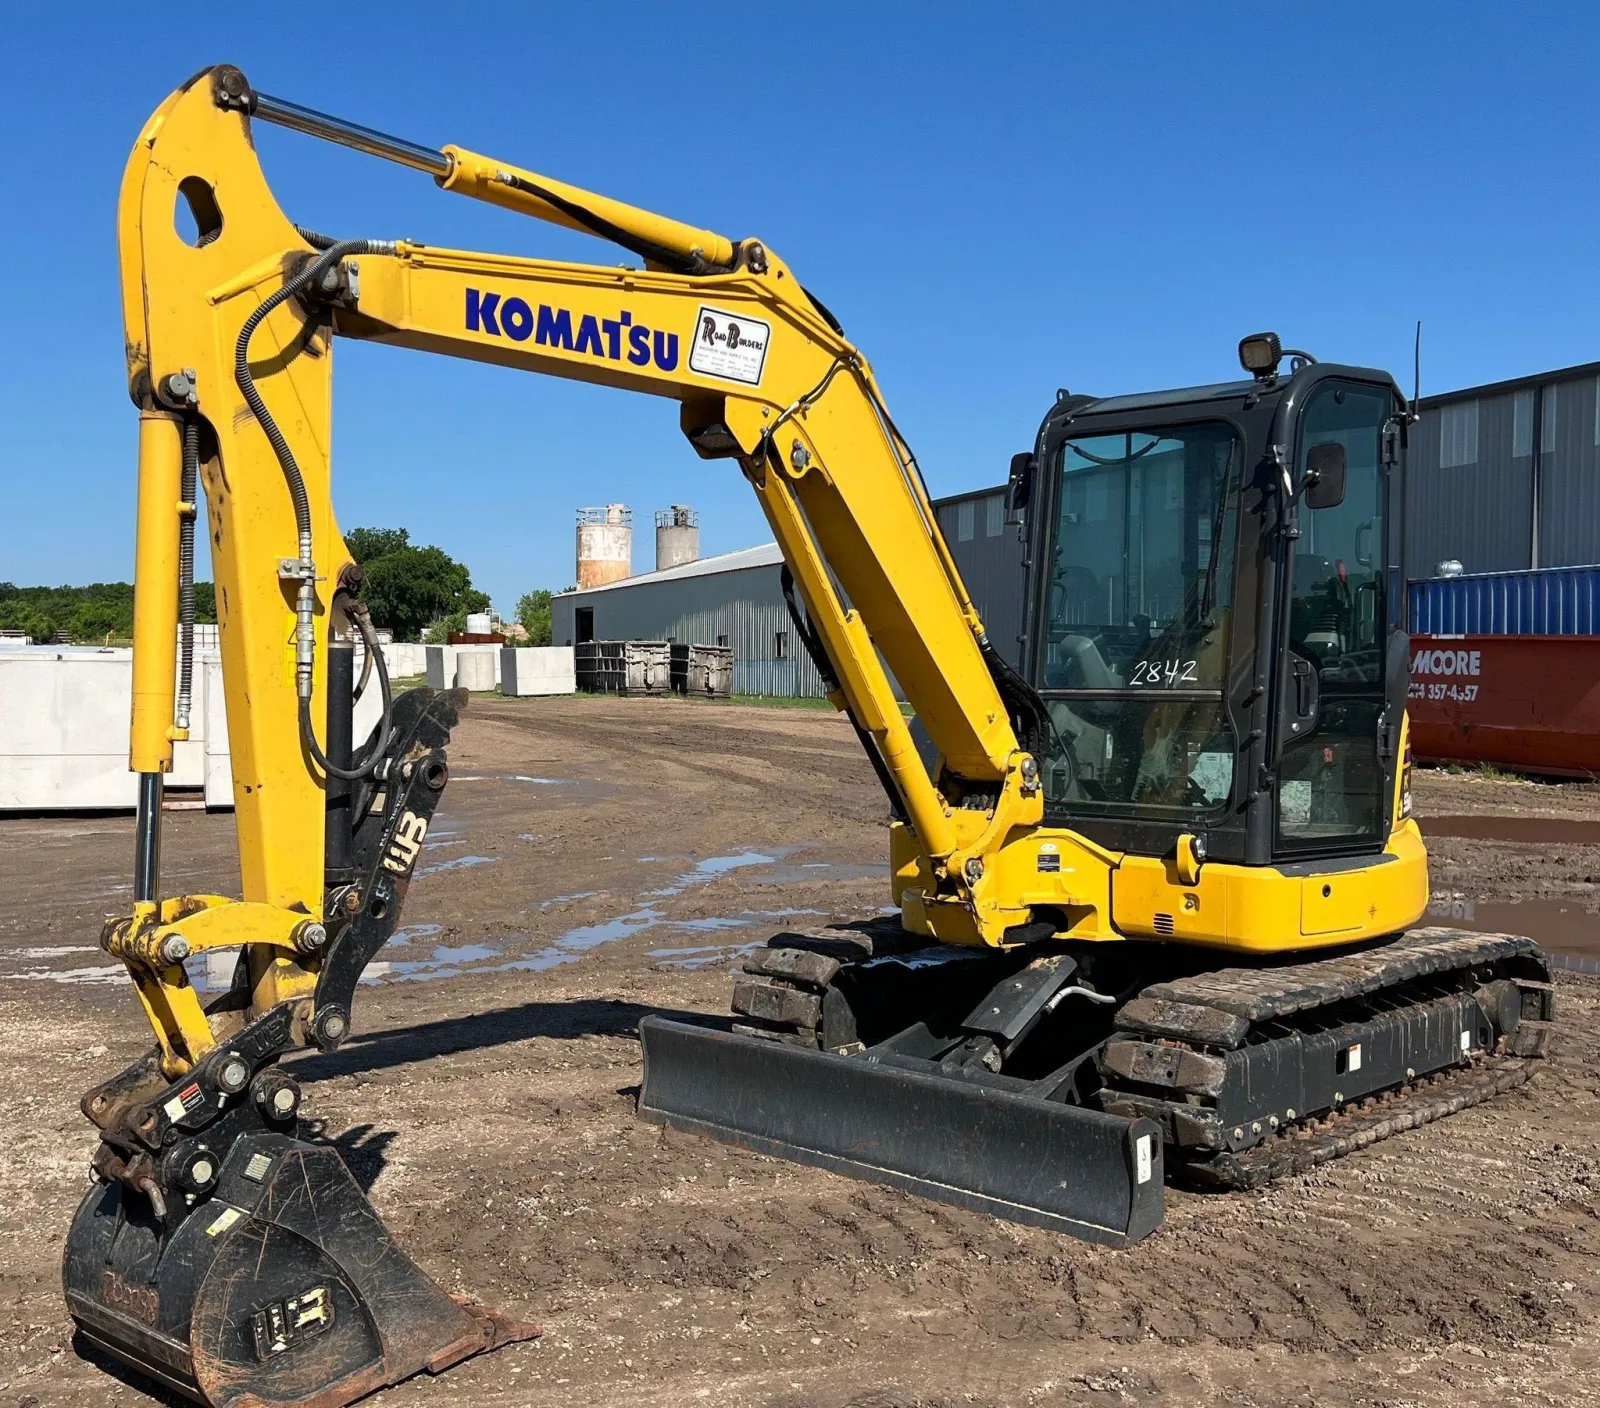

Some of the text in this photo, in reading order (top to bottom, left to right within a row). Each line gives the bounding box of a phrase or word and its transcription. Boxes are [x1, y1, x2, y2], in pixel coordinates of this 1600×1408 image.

[465, 287, 679, 372] KOMATSU
[1129, 658, 1198, 686] 2842
[1411, 649, 1481, 676] MOORE
